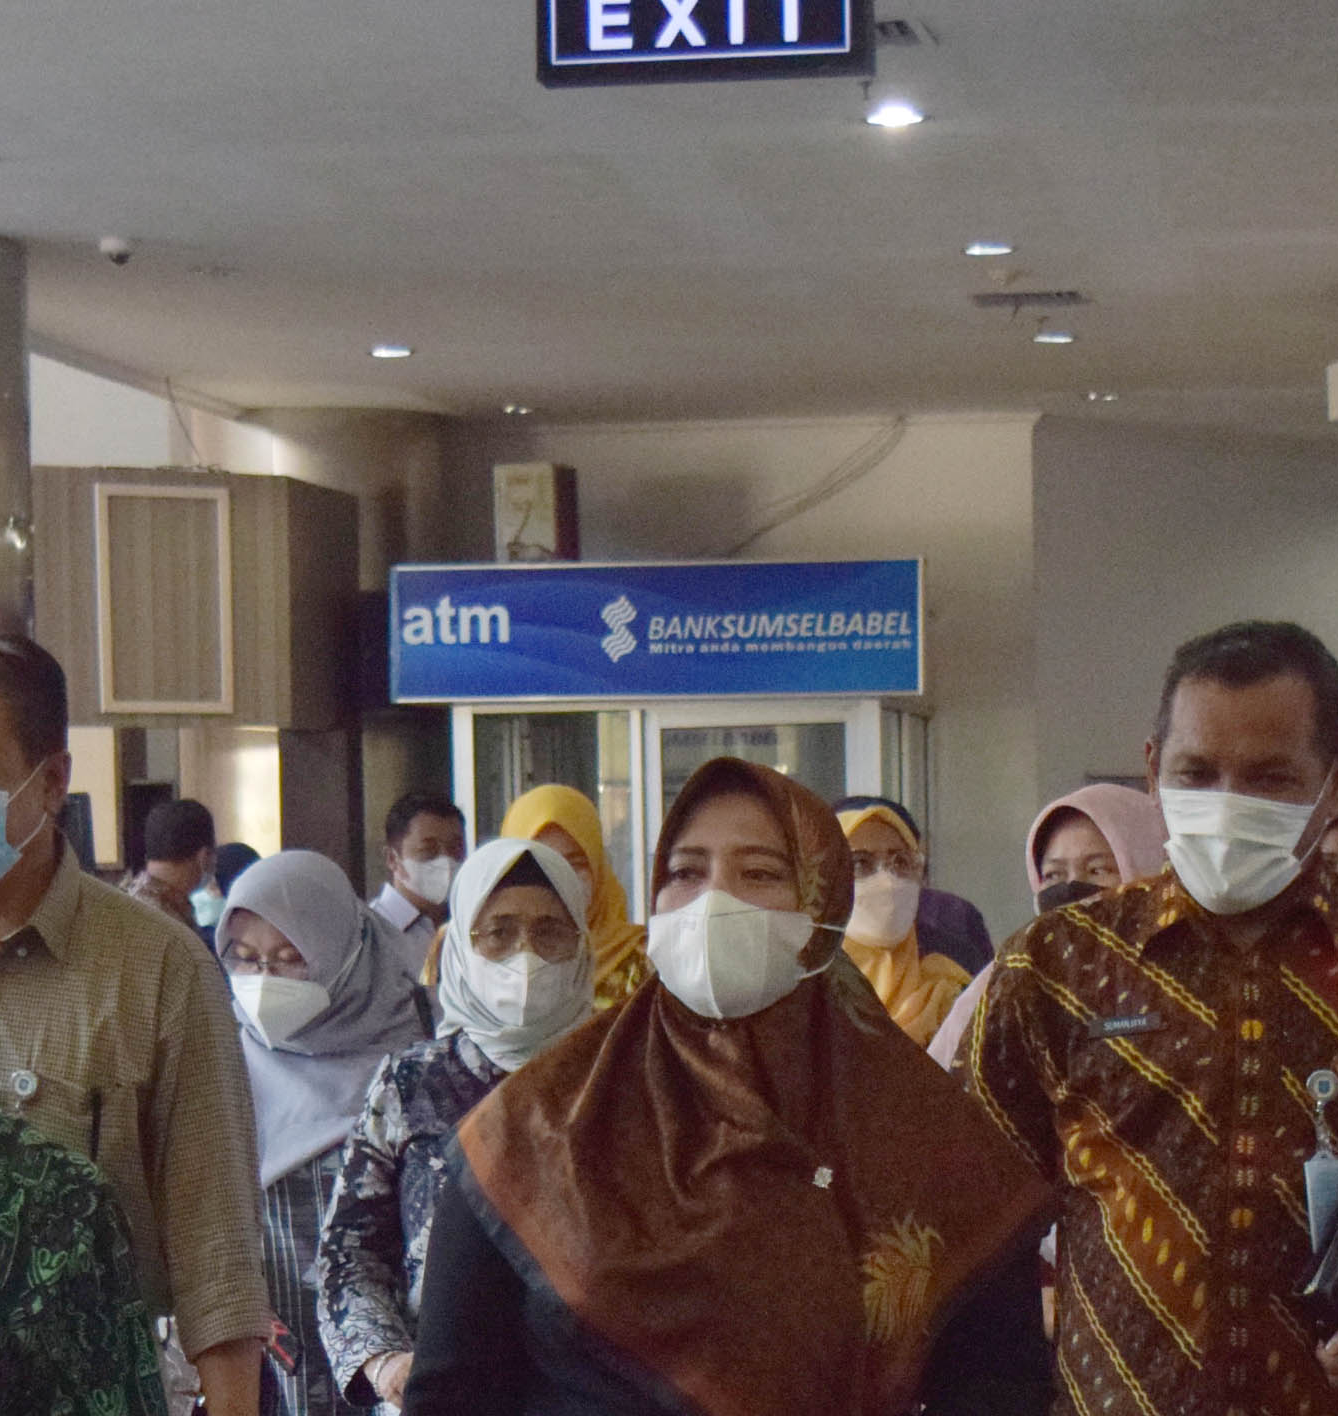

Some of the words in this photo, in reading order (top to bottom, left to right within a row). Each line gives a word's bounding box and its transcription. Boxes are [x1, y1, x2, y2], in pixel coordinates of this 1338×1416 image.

[587, 0, 801, 51] EXIT
[403, 594, 511, 645] atm
[648, 611, 912, 640] BANKSUMSELBABEL
[649, 640, 695, 655] Mitra
[699, 640, 741, 654] anda
